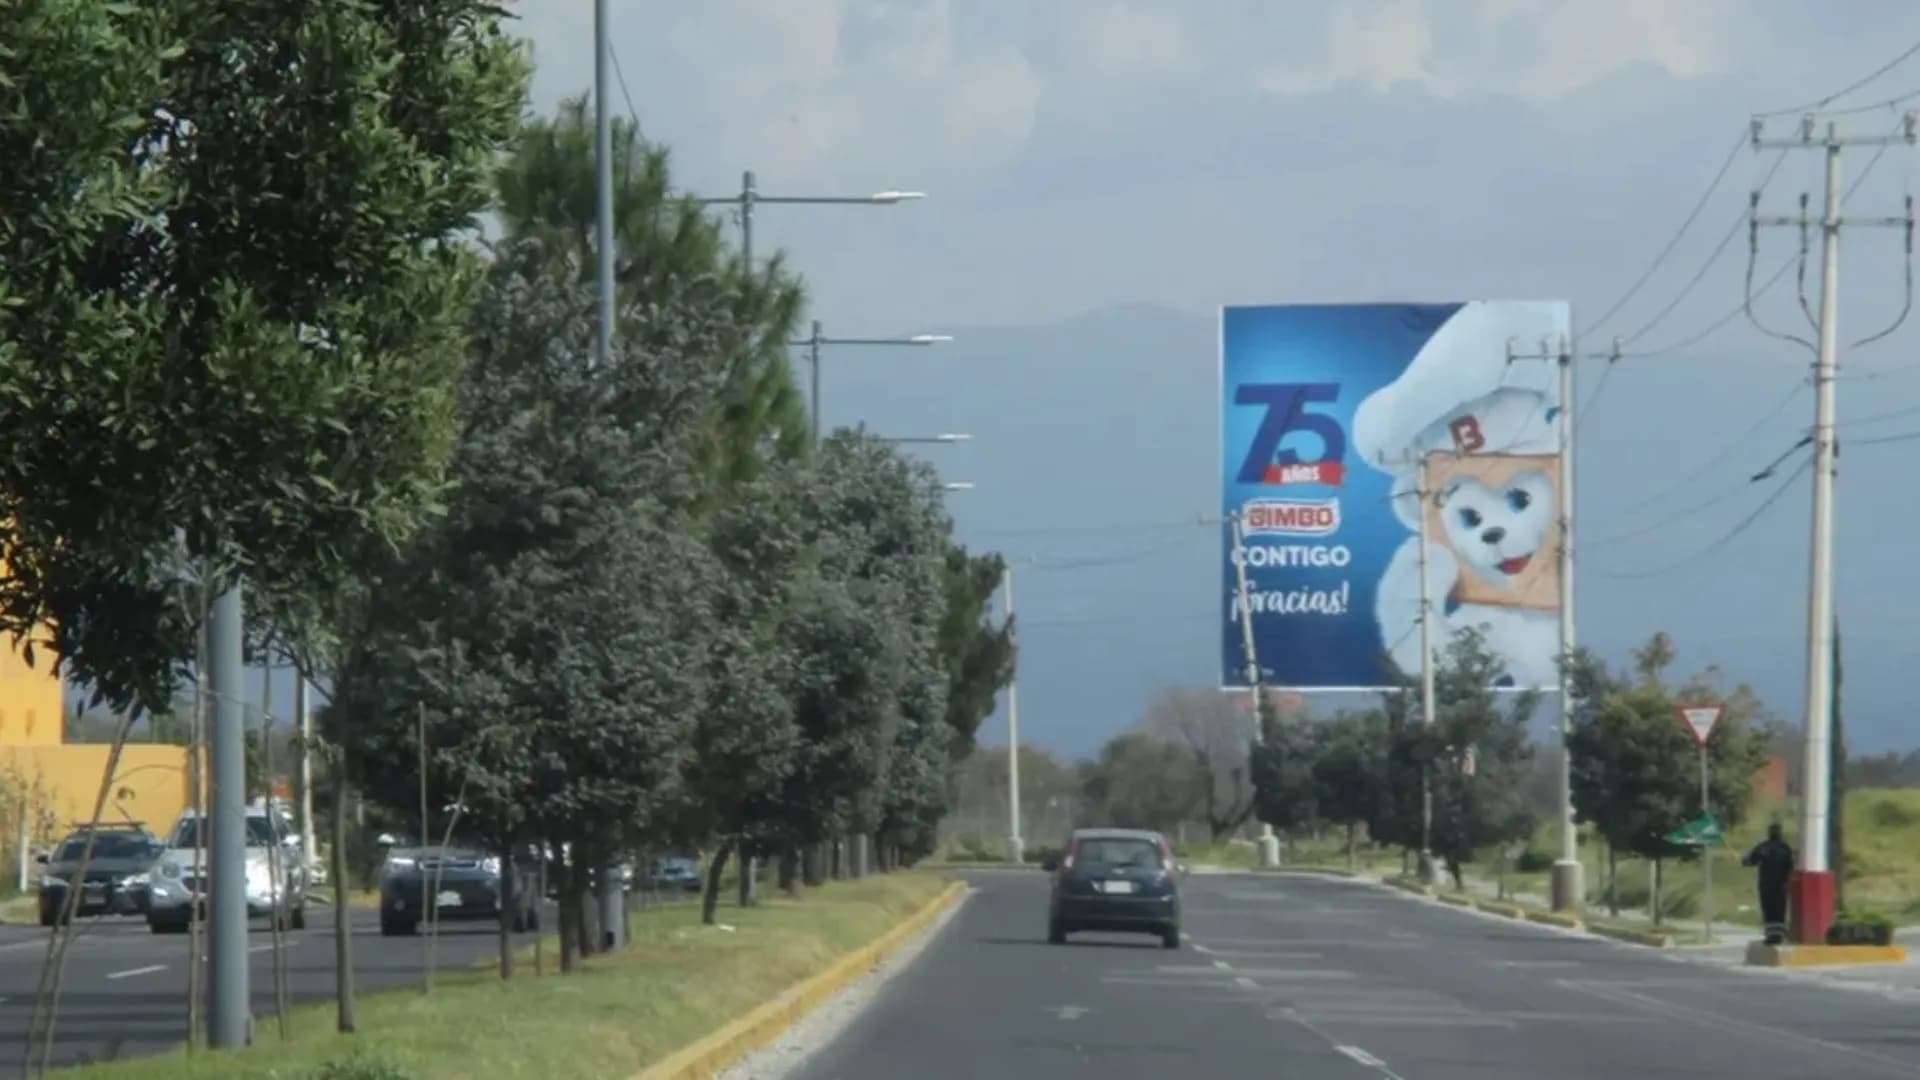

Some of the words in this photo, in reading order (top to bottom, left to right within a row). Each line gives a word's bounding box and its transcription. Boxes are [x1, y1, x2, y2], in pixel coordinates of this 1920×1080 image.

[1235, 383, 1346, 483] 75
[1449, 414, 1485, 453] B
[1248, 507, 1334, 527] BIMBO
